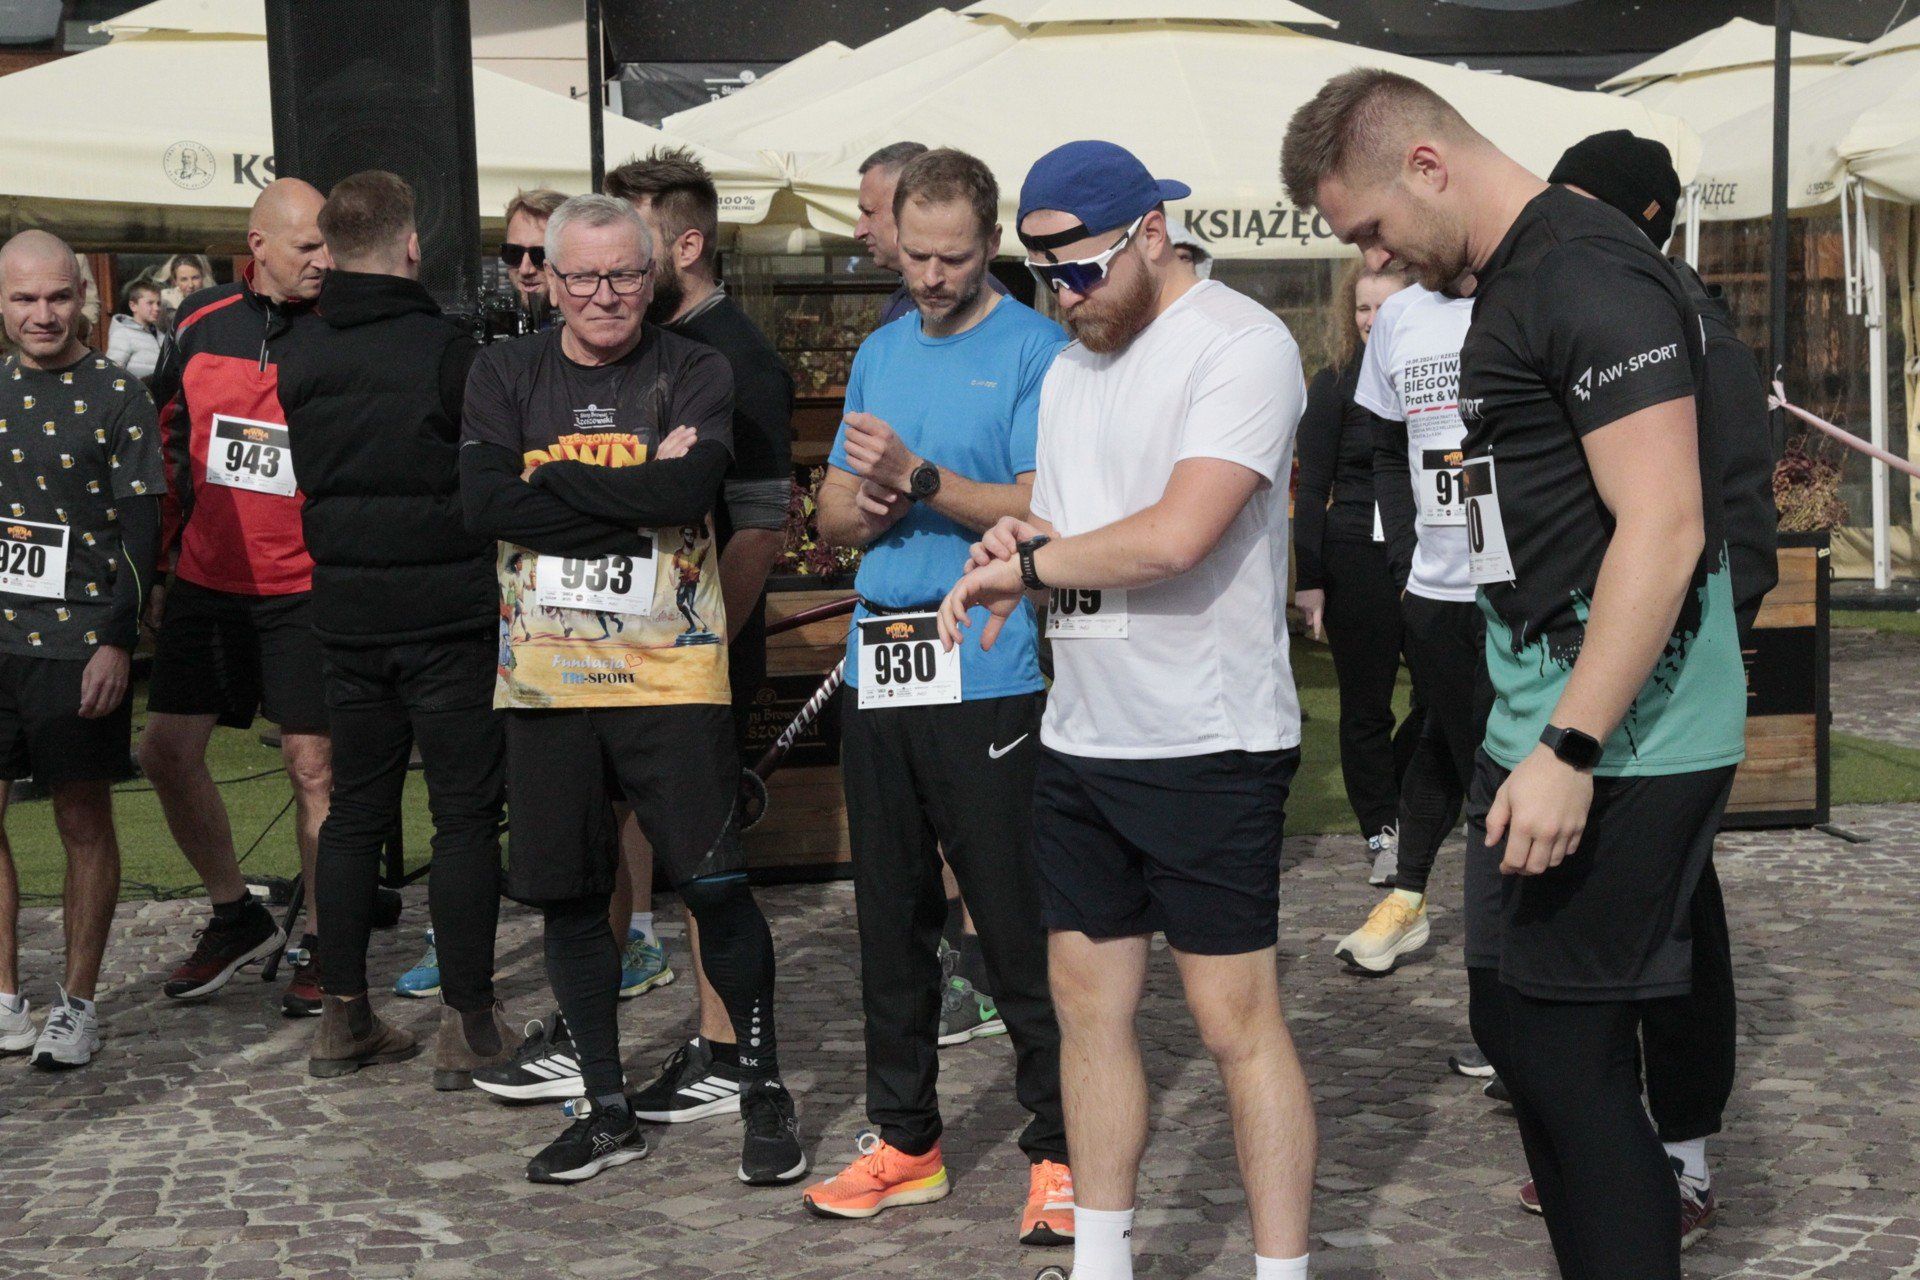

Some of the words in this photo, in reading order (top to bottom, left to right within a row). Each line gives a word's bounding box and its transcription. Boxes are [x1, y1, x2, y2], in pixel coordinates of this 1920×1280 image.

[1404, 360, 1461, 380] FESTIW
[1598, 343, 1677, 387] AW-SPORT
[1405, 393, 1434, 407] Pratt
[1437, 391, 1446, 402] &
[558, 432, 640, 445] RZESZOWSKA
[226, 441, 281, 478] 943
[560, 555, 634, 595] 933
[551, 654, 626, 671] Fundacja
[875, 642, 936, 685] 930
